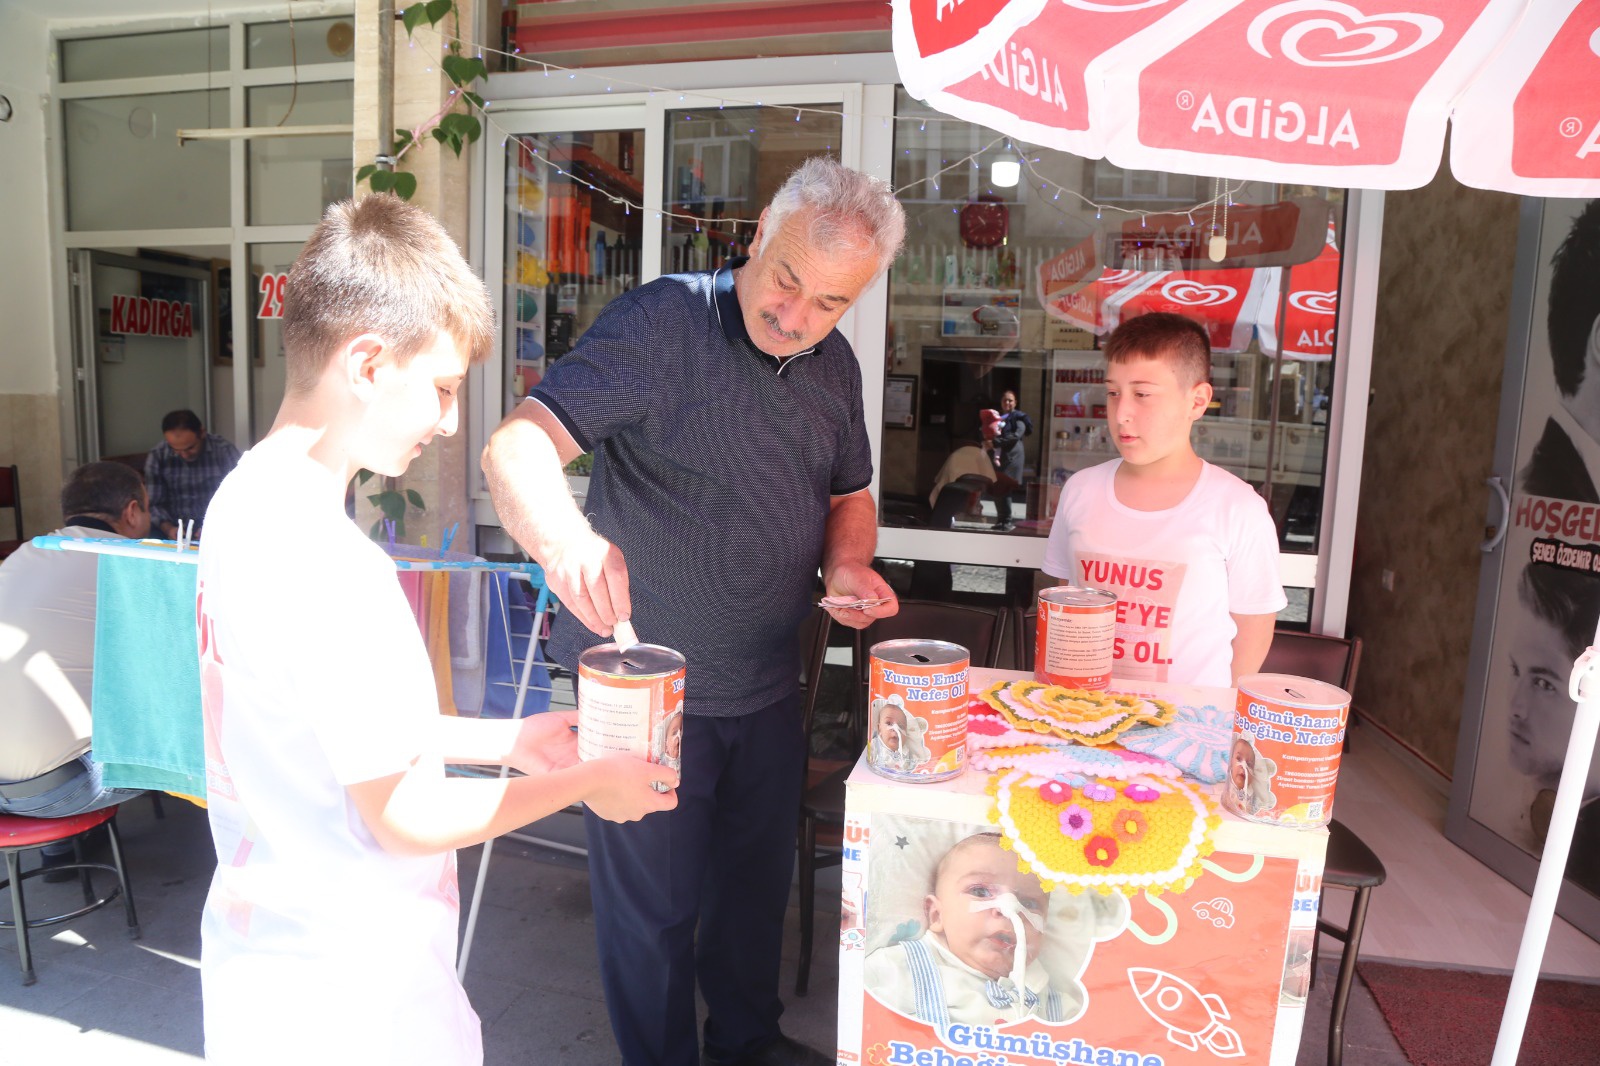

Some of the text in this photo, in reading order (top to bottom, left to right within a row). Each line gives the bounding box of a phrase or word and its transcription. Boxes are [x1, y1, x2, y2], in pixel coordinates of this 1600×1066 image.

[110, 294, 193, 338] KADIRGA
[1080, 558, 1165, 591] YUNUS
[1133, 641, 1173, 665] OL.
[883, 669, 930, 687] Yunus
[907, 688, 949, 701] Nefes
[1248, 703, 1338, 732] Gümüşhane
[1295, 731, 1336, 745] Nefes
[948, 1024, 1162, 1066] Gümüşhane
